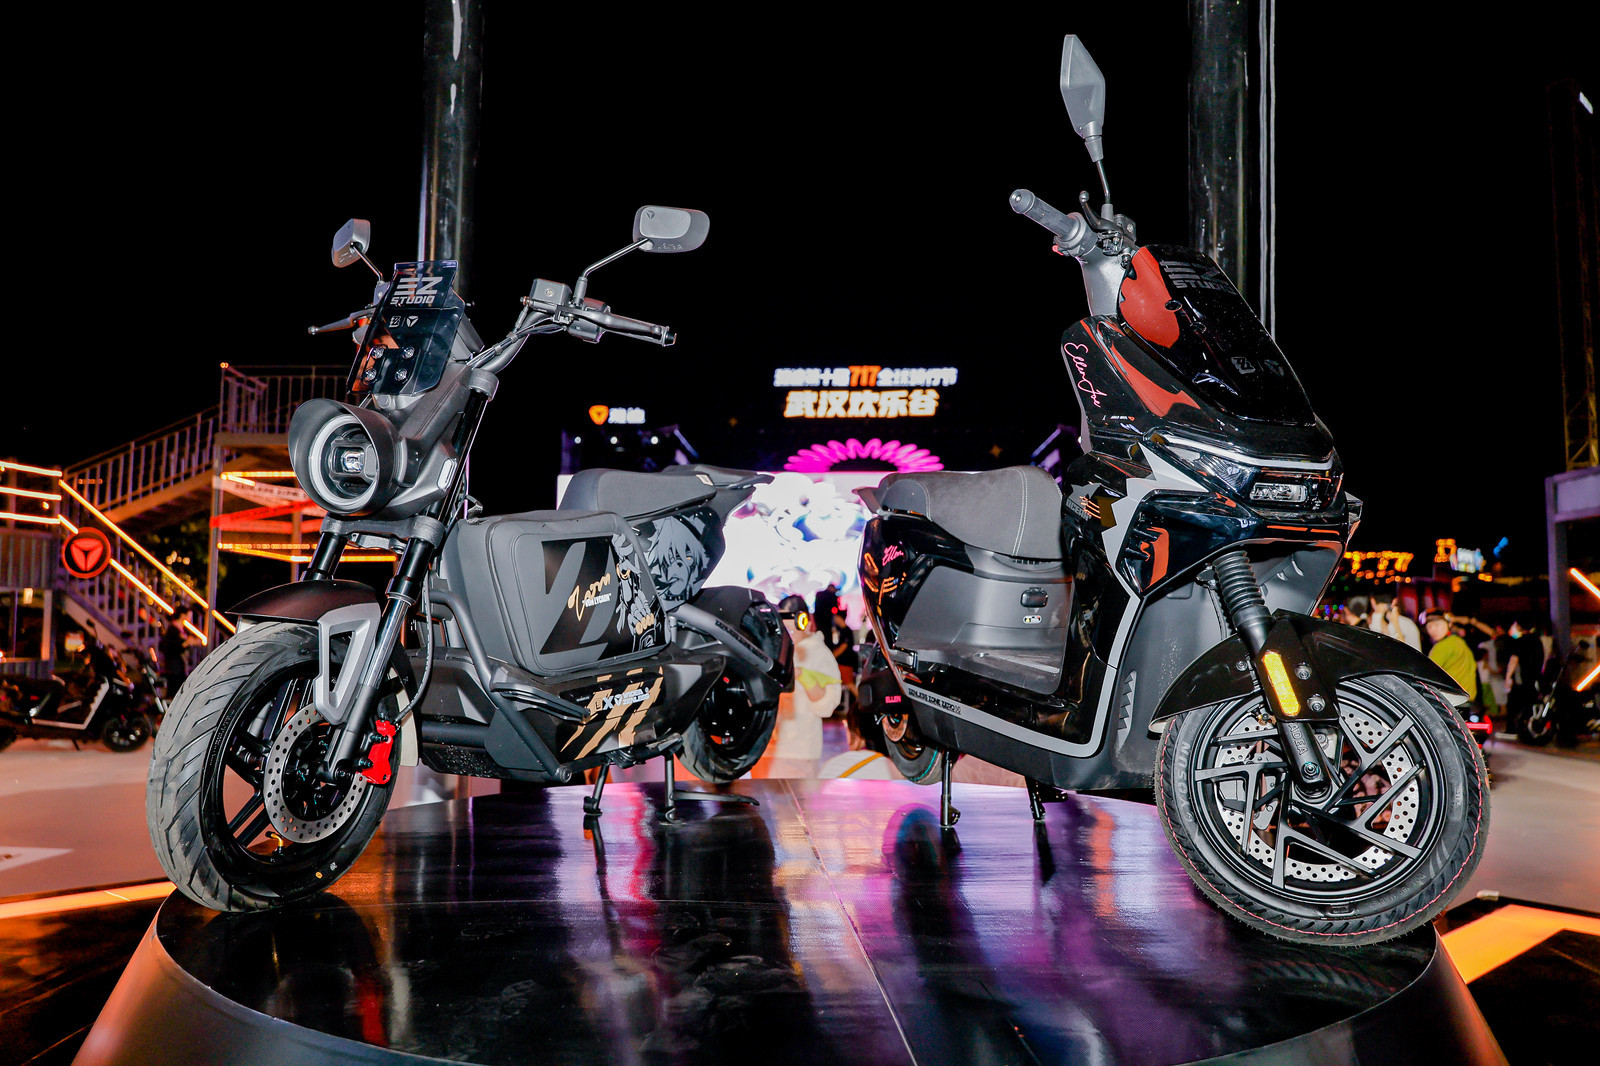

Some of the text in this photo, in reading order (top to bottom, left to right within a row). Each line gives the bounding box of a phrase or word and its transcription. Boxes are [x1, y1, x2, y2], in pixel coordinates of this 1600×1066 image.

[1172, 279, 1238, 296] STUDIO
[390, 295, 436, 305] STUDIO
[783, 389, 940, 418] 武汉欢乐谷
[1288, 722, 1309, 756] ADEA
